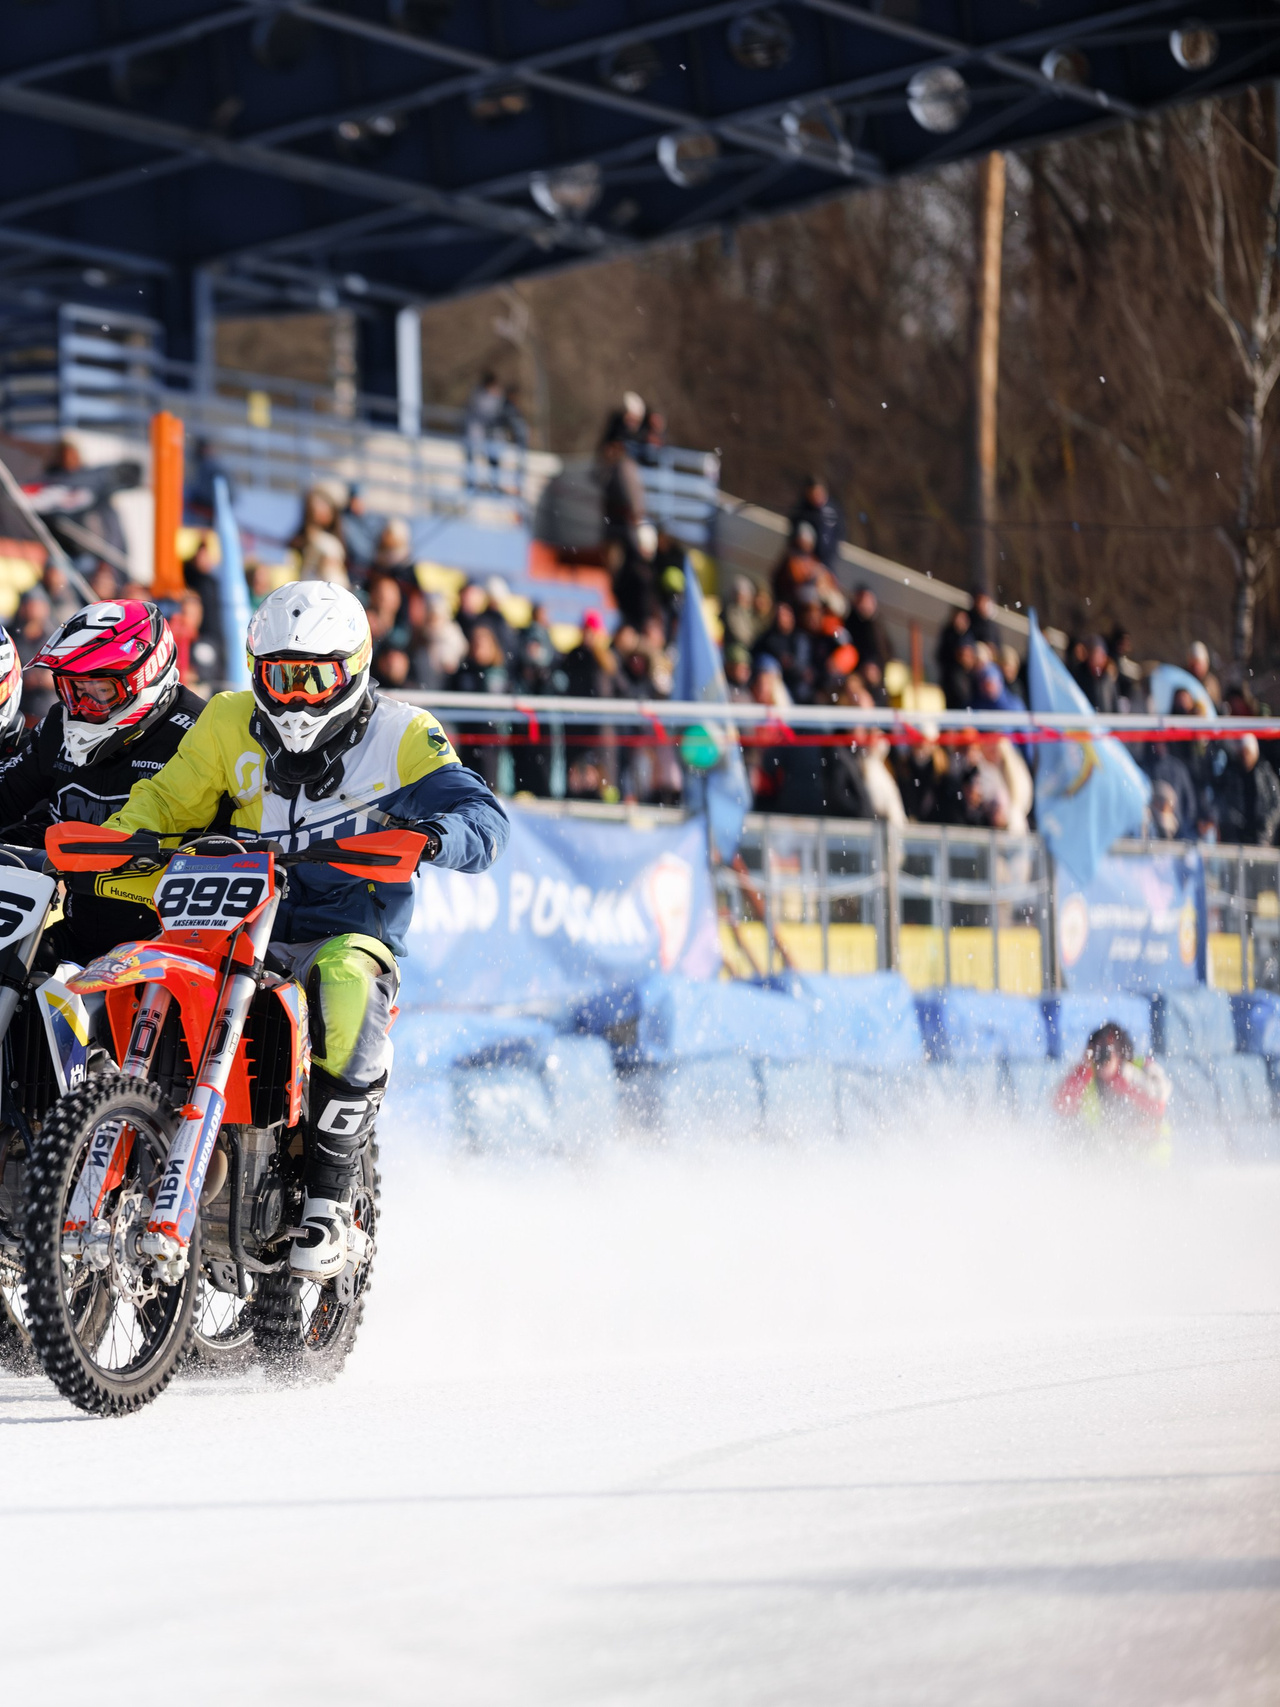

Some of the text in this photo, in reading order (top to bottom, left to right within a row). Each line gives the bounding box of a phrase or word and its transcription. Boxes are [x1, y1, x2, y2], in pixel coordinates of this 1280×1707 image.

[157, 877, 265, 918] 899
[172, 919, 228, 927] AKSENENKO IVAN
[196, 1102, 223, 1177] DUNLOP
